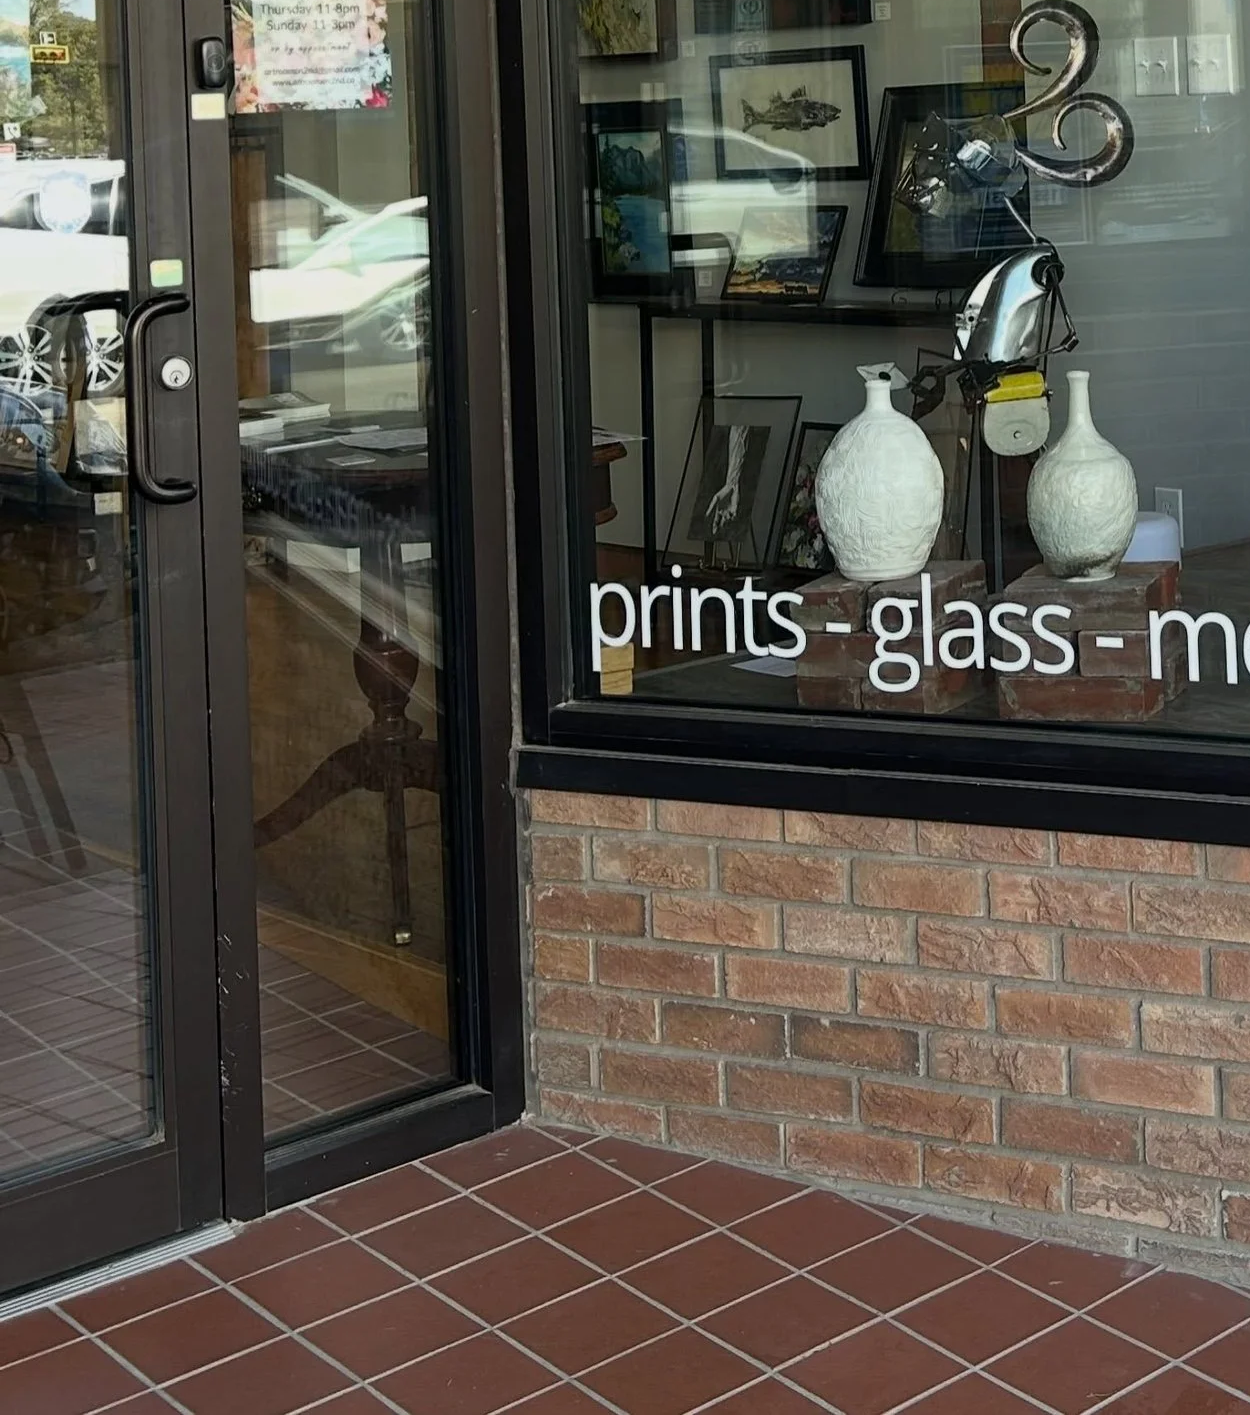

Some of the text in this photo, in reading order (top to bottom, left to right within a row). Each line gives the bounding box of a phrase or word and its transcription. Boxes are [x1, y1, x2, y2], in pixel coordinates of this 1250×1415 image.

[260, 3, 311, 16] Thursday
[266, 19, 307, 32] Sunday
[590, 565, 808, 673] prints
[868, 573, 1075, 693] glass
